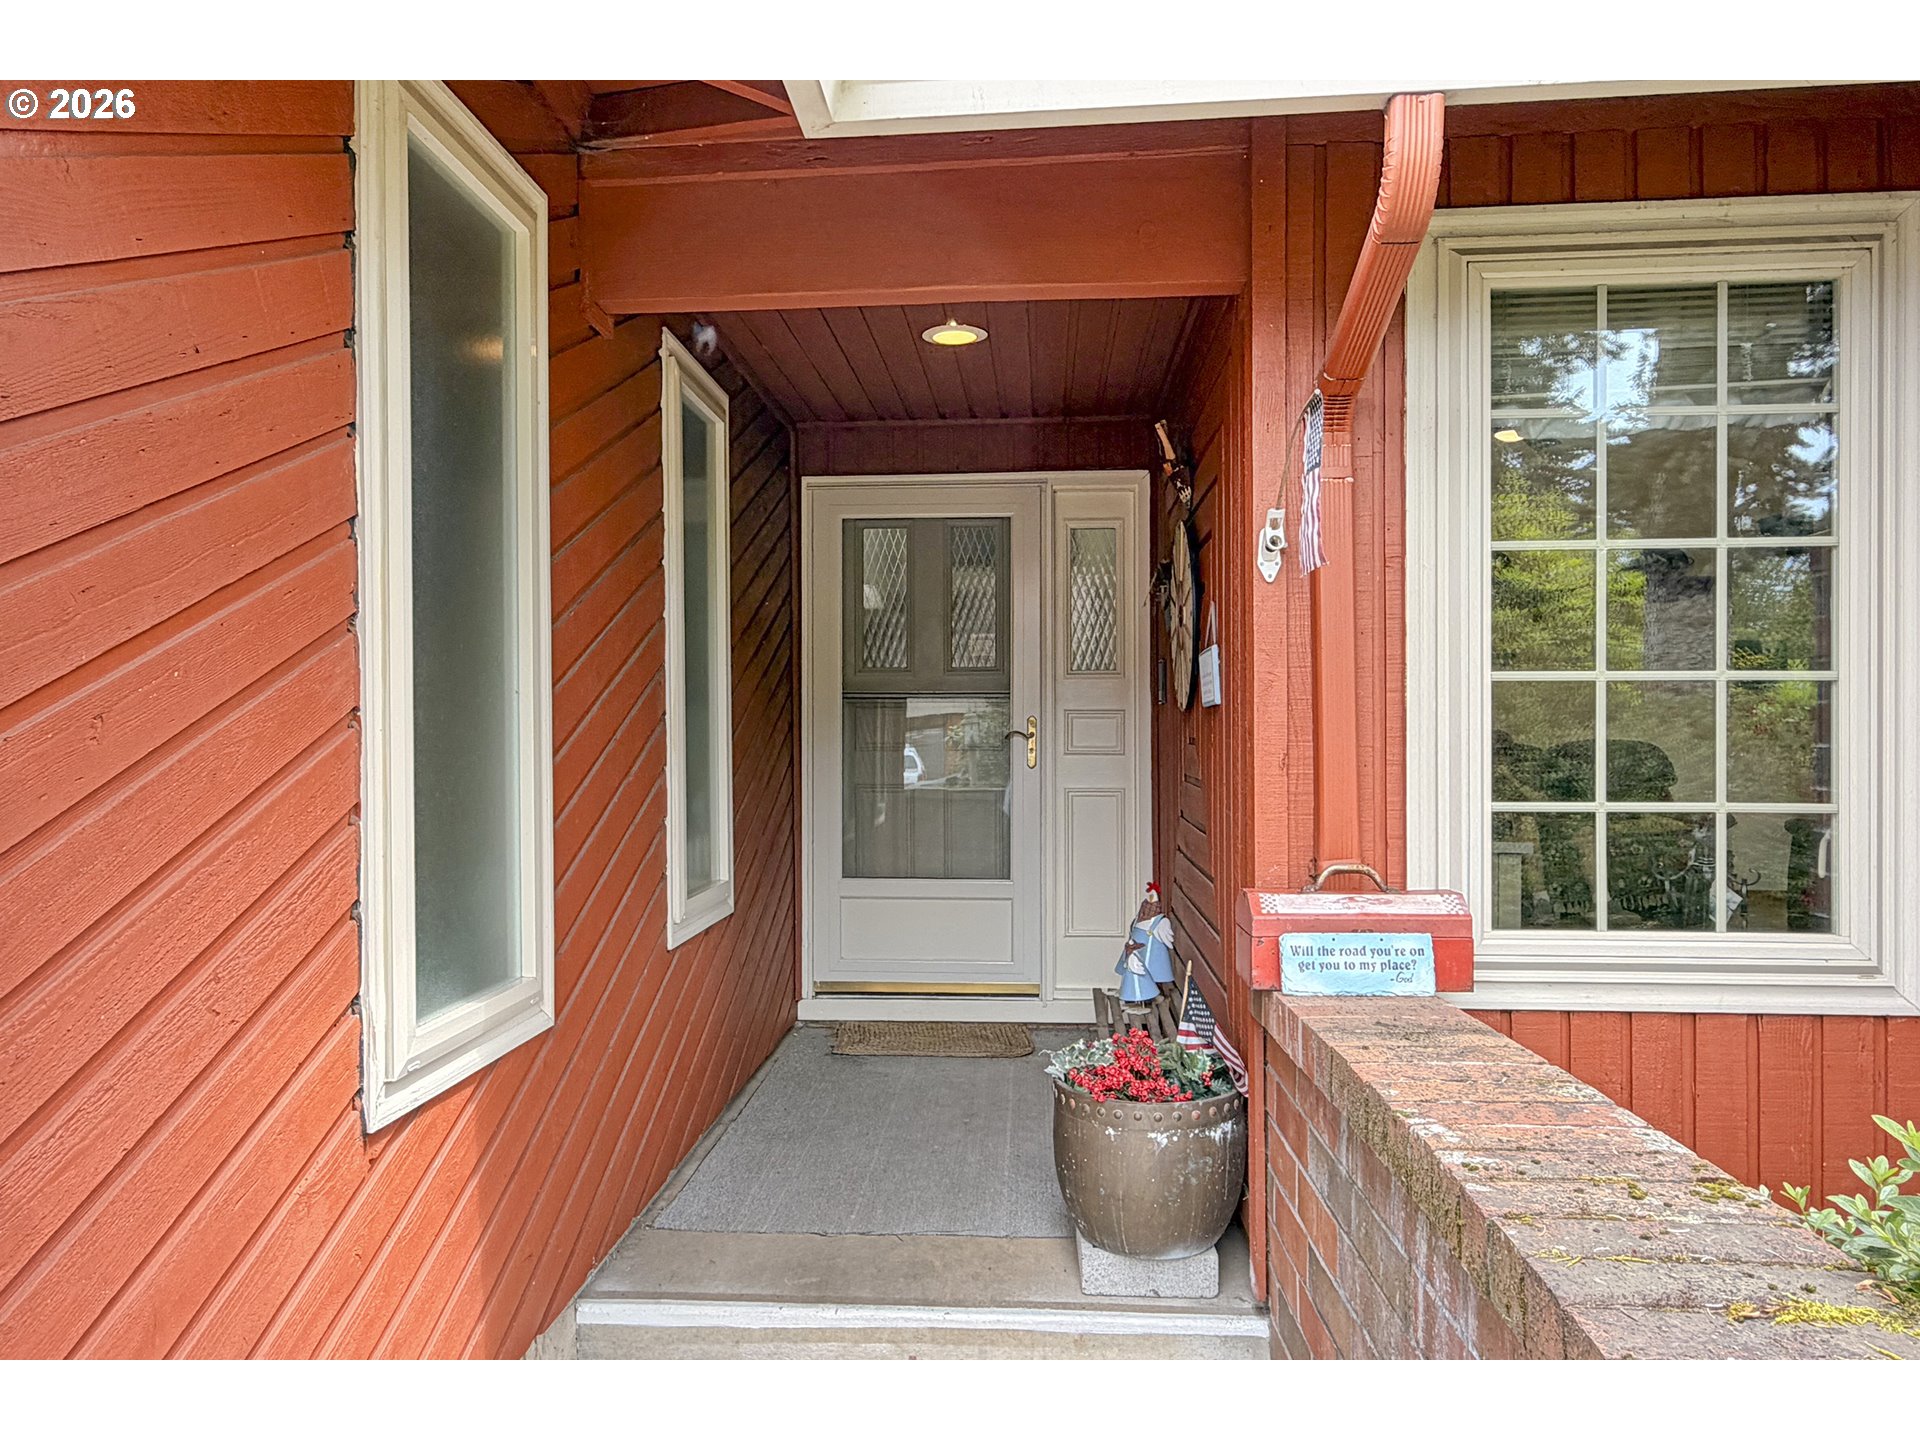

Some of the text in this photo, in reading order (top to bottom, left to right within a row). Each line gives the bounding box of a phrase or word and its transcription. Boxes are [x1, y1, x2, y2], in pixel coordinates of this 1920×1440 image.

[1290, 945, 1425, 959] Will the road you're on
[1298, 959, 1417, 973] get you to my place?
